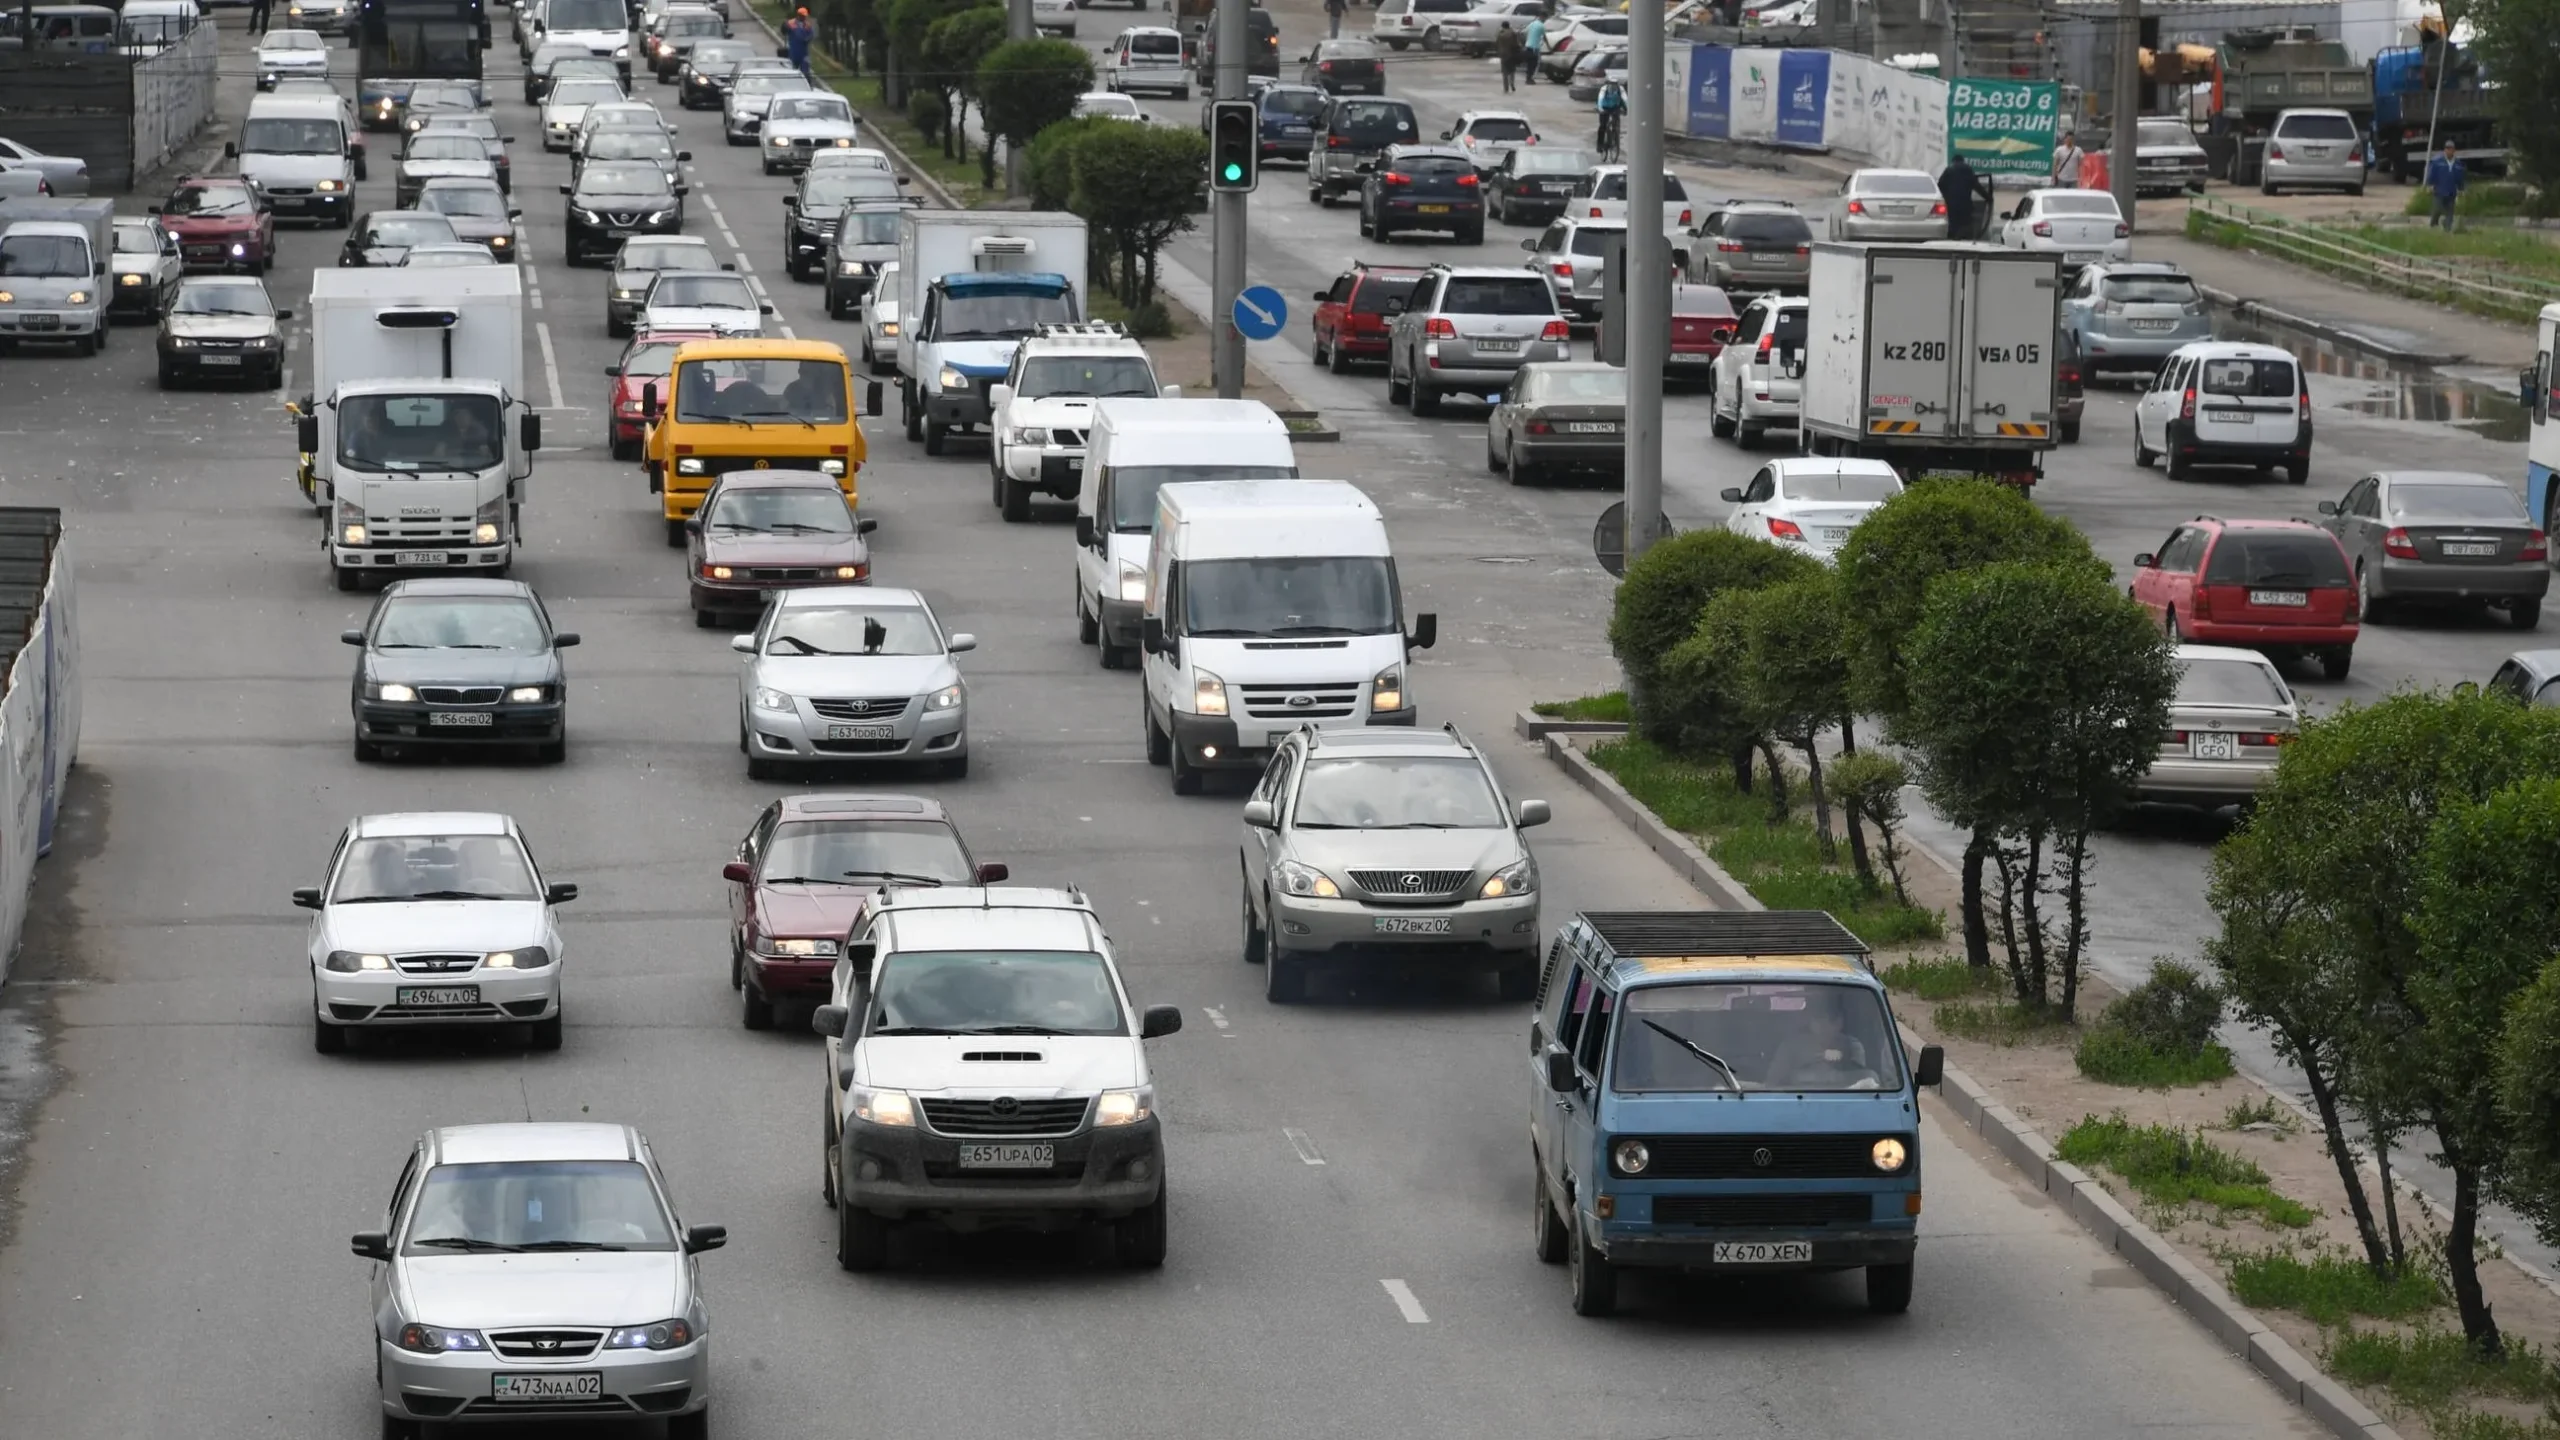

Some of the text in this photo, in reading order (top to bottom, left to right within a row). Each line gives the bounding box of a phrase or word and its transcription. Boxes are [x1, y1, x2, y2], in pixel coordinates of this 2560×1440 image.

[1952, 83, 2052, 110] Въезд в
[1952, 111, 2054, 131] магазин
[2016, 344, 2039, 363] 05
[401, 506, 440, 515] ISUZU
[2197, 733, 2230, 746] B 154
[2201, 745, 2226, 756] CFO
[1719, 1244, 1808, 1261] X 670 XEN
